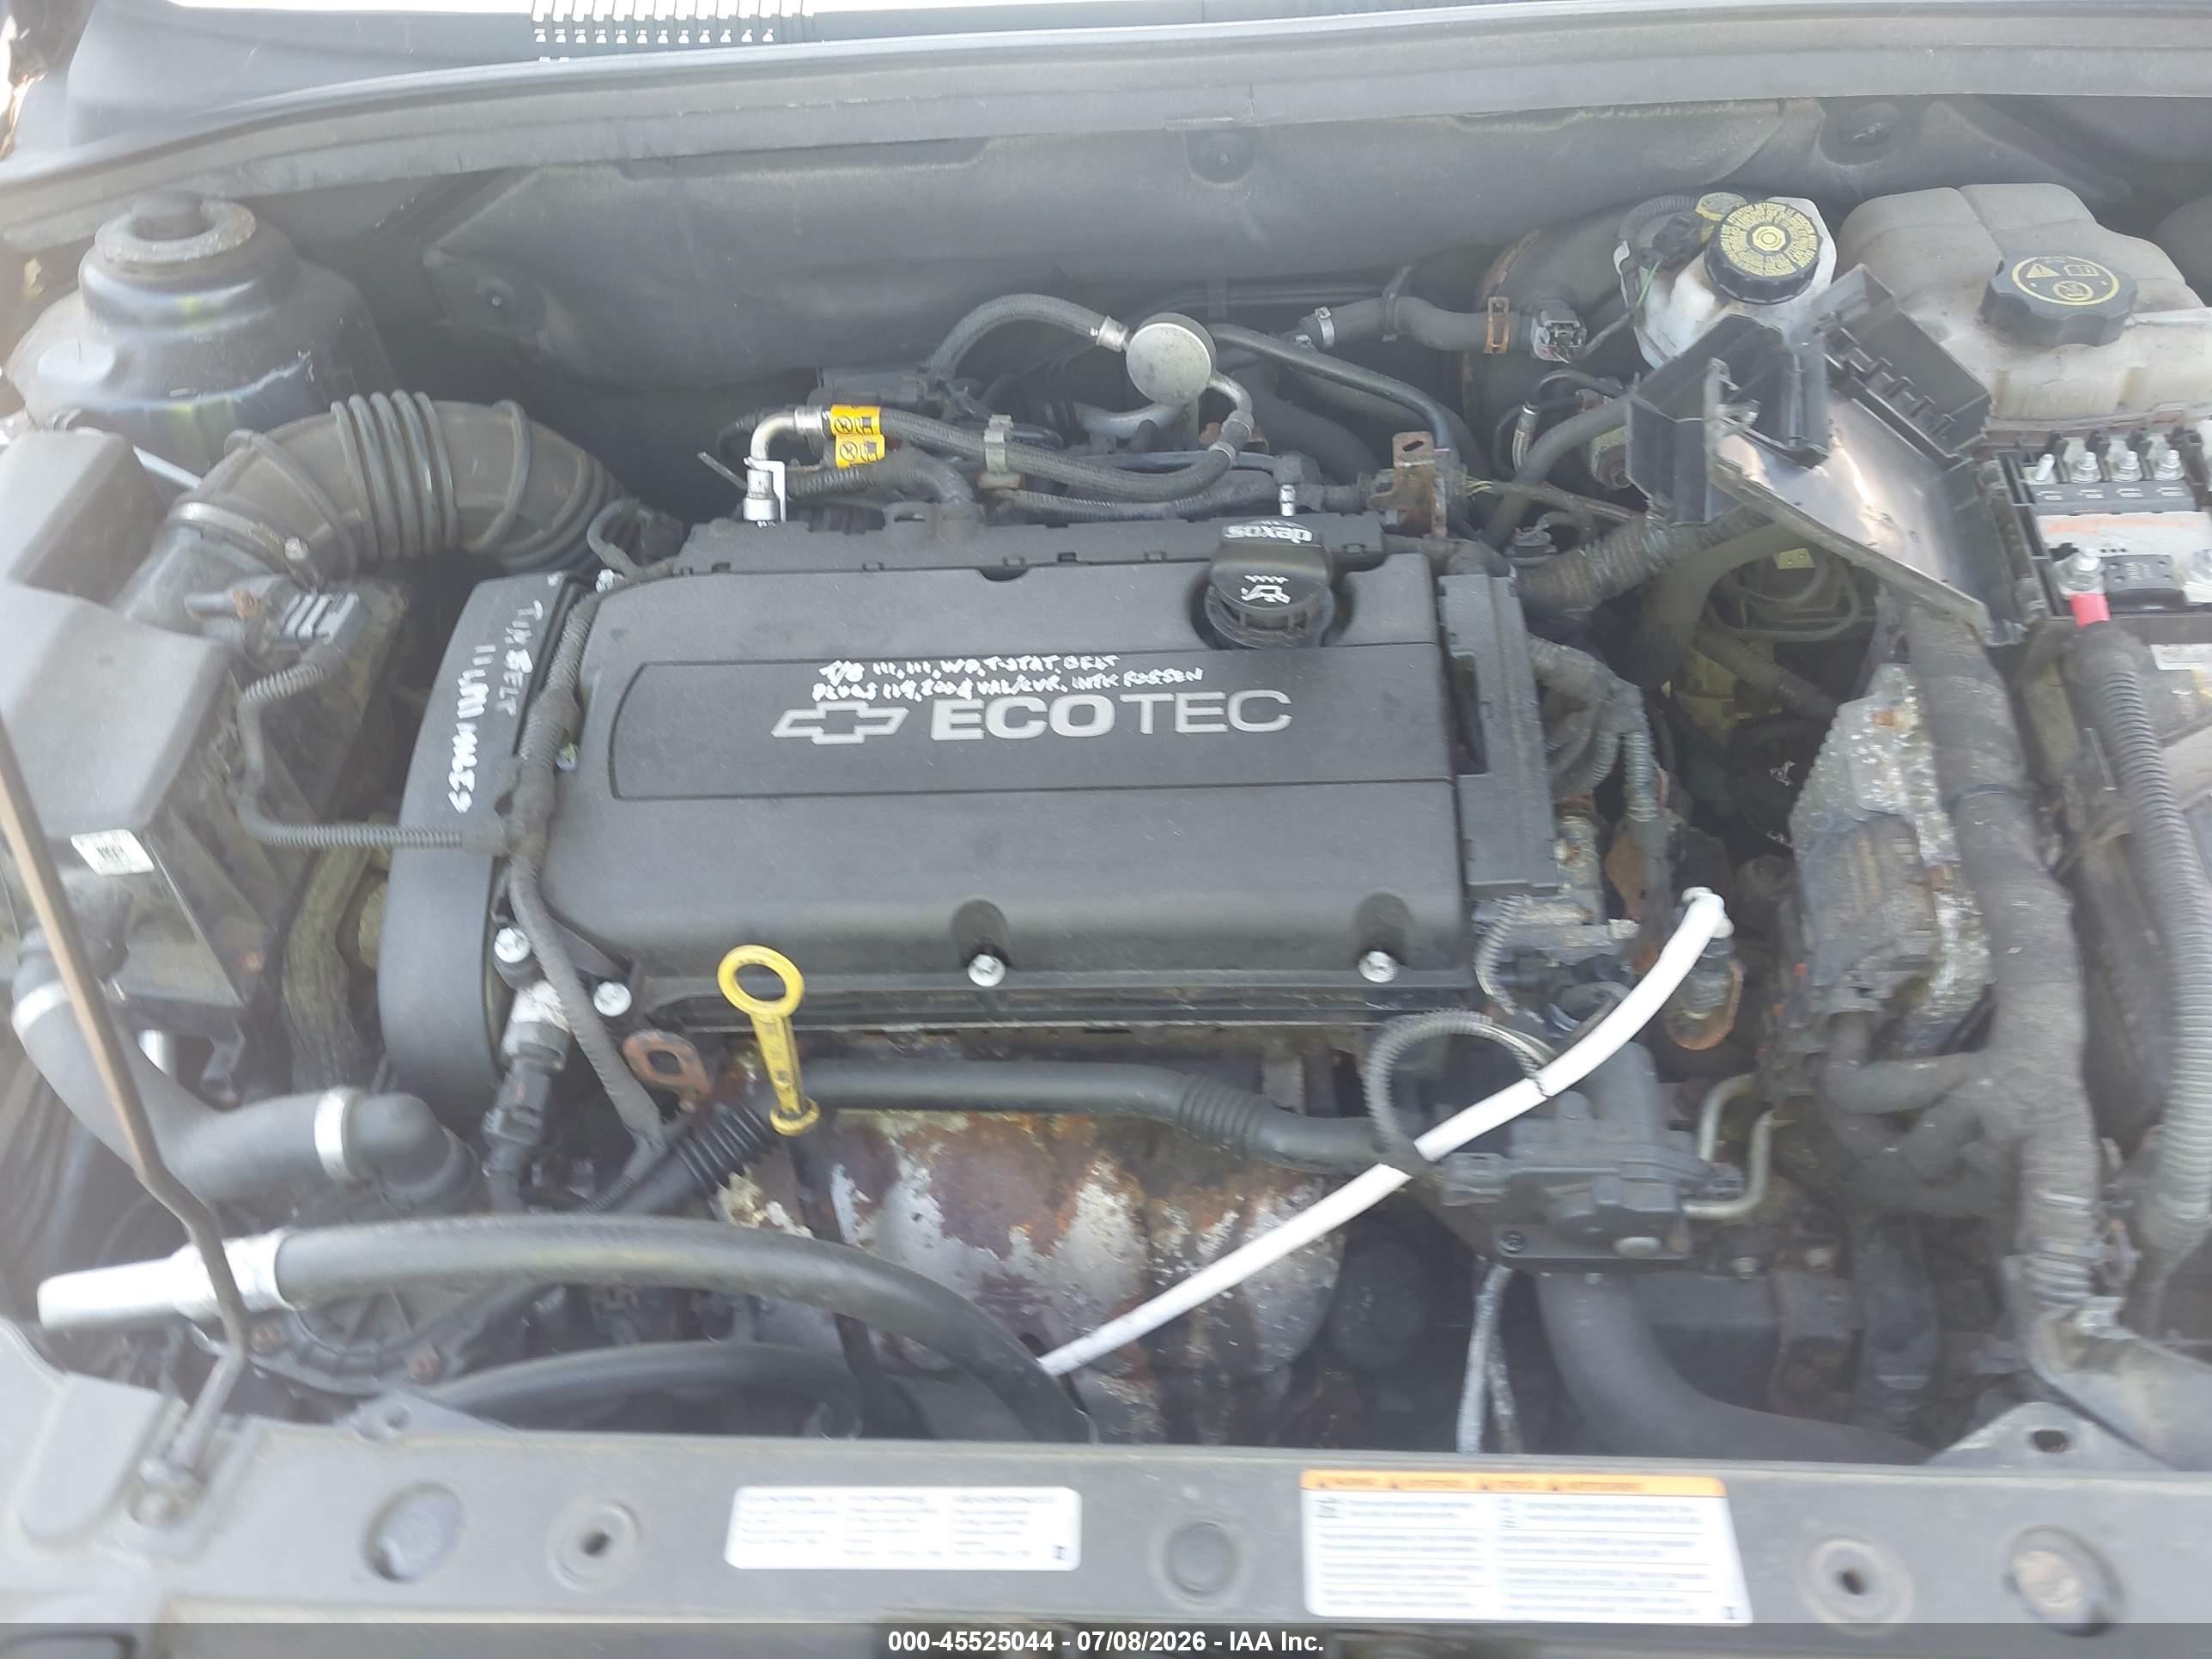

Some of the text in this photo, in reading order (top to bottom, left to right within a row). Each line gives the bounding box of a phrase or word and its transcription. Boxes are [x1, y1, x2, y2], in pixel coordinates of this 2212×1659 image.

[1224, 526, 1313, 544] dexos
[495, 648, 534, 717] BELT
[930, 690, 1293, 741] ECOTEC
[447, 721, 478, 814] MILES
